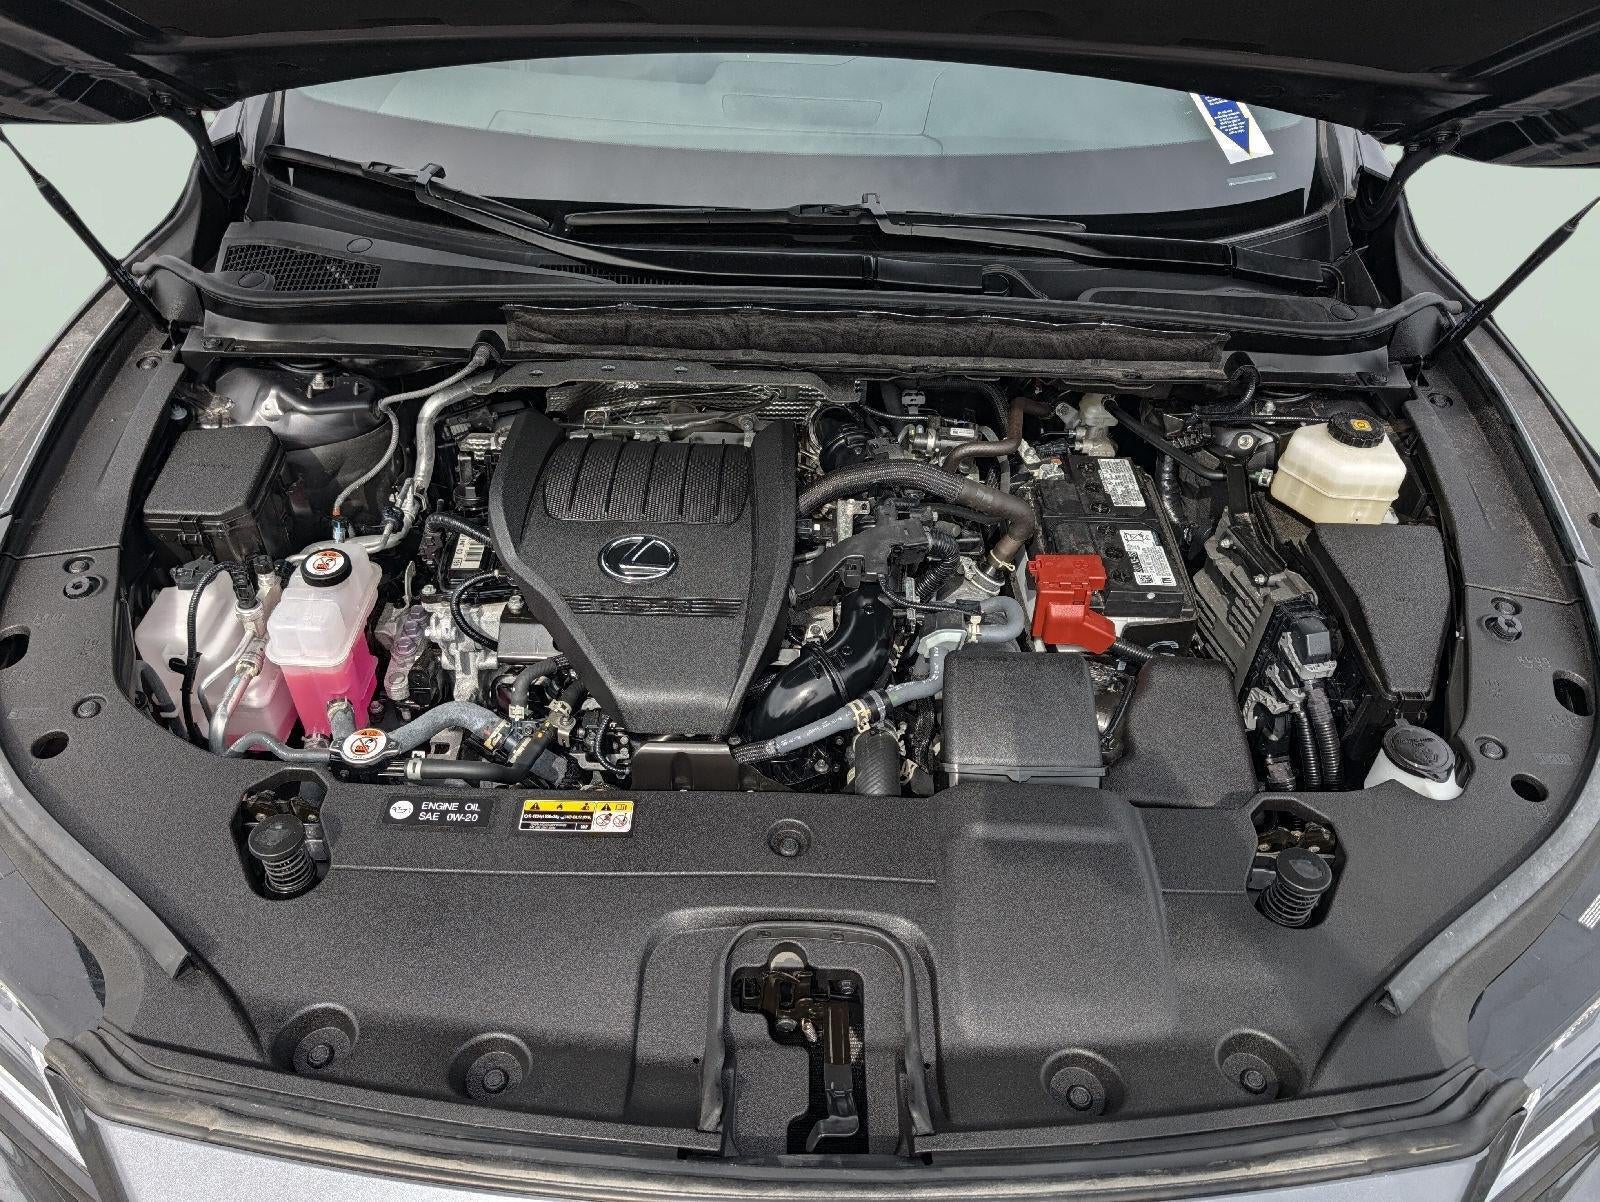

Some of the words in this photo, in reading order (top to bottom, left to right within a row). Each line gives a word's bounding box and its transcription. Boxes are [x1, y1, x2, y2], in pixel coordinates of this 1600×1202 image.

[421, 801, 459, 811] ENGINE
[464, 802, 480, 812] OIL
[418, 811, 440, 821] SAE
[446, 813, 479, 822] 0W-20
